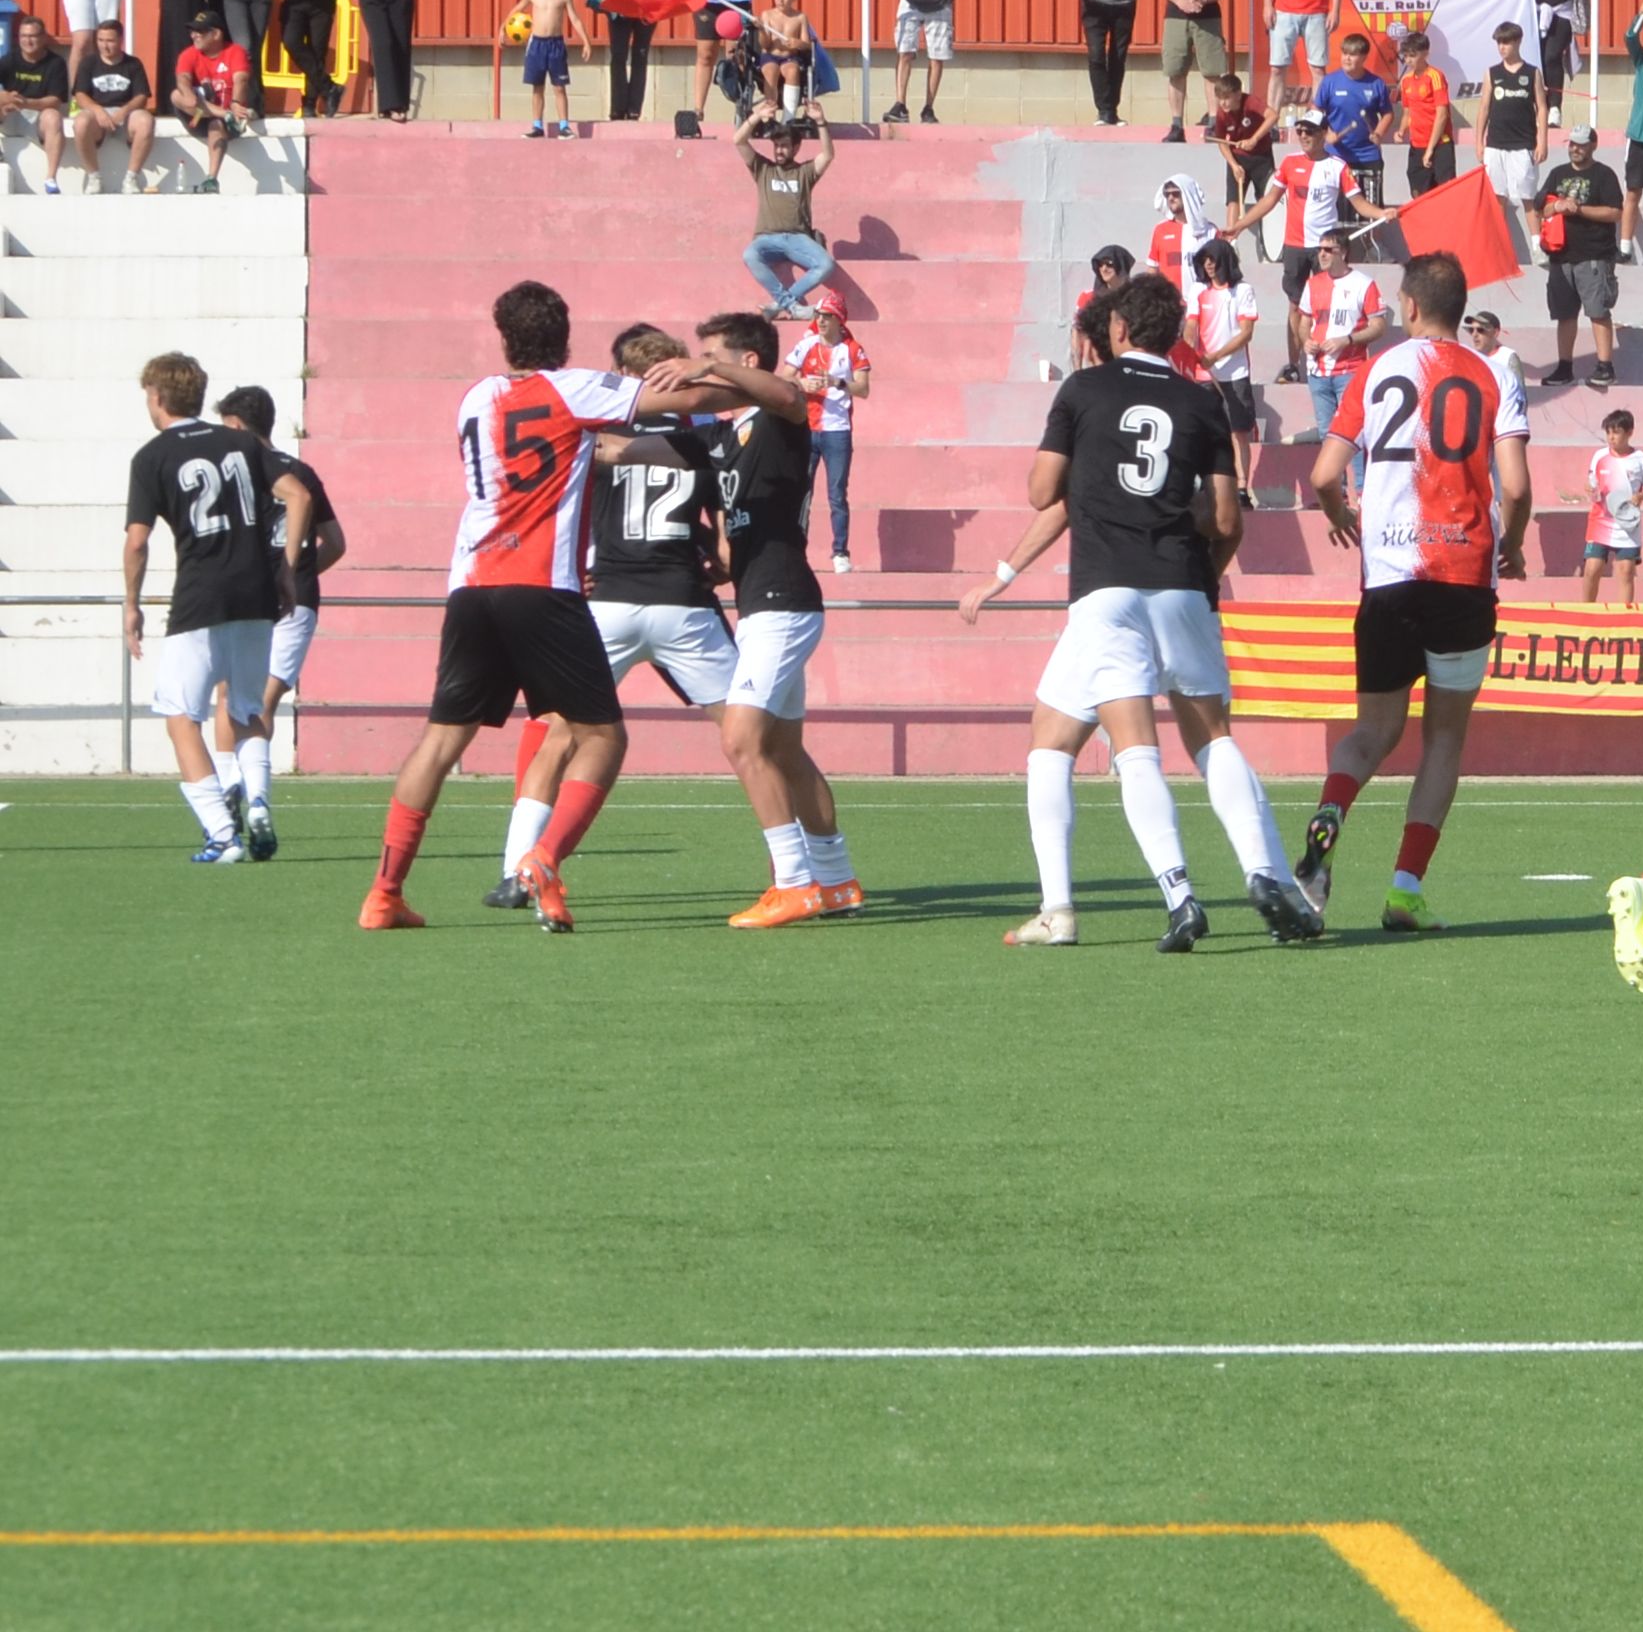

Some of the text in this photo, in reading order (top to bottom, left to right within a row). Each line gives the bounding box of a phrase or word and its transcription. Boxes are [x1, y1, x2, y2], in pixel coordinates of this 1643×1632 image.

[462, 405, 556, 501] 15
[1117, 404, 1173, 497] 3
[1371, 375, 1483, 464] 20
[178, 451, 256, 538] 21
[612, 464, 696, 541] 12
